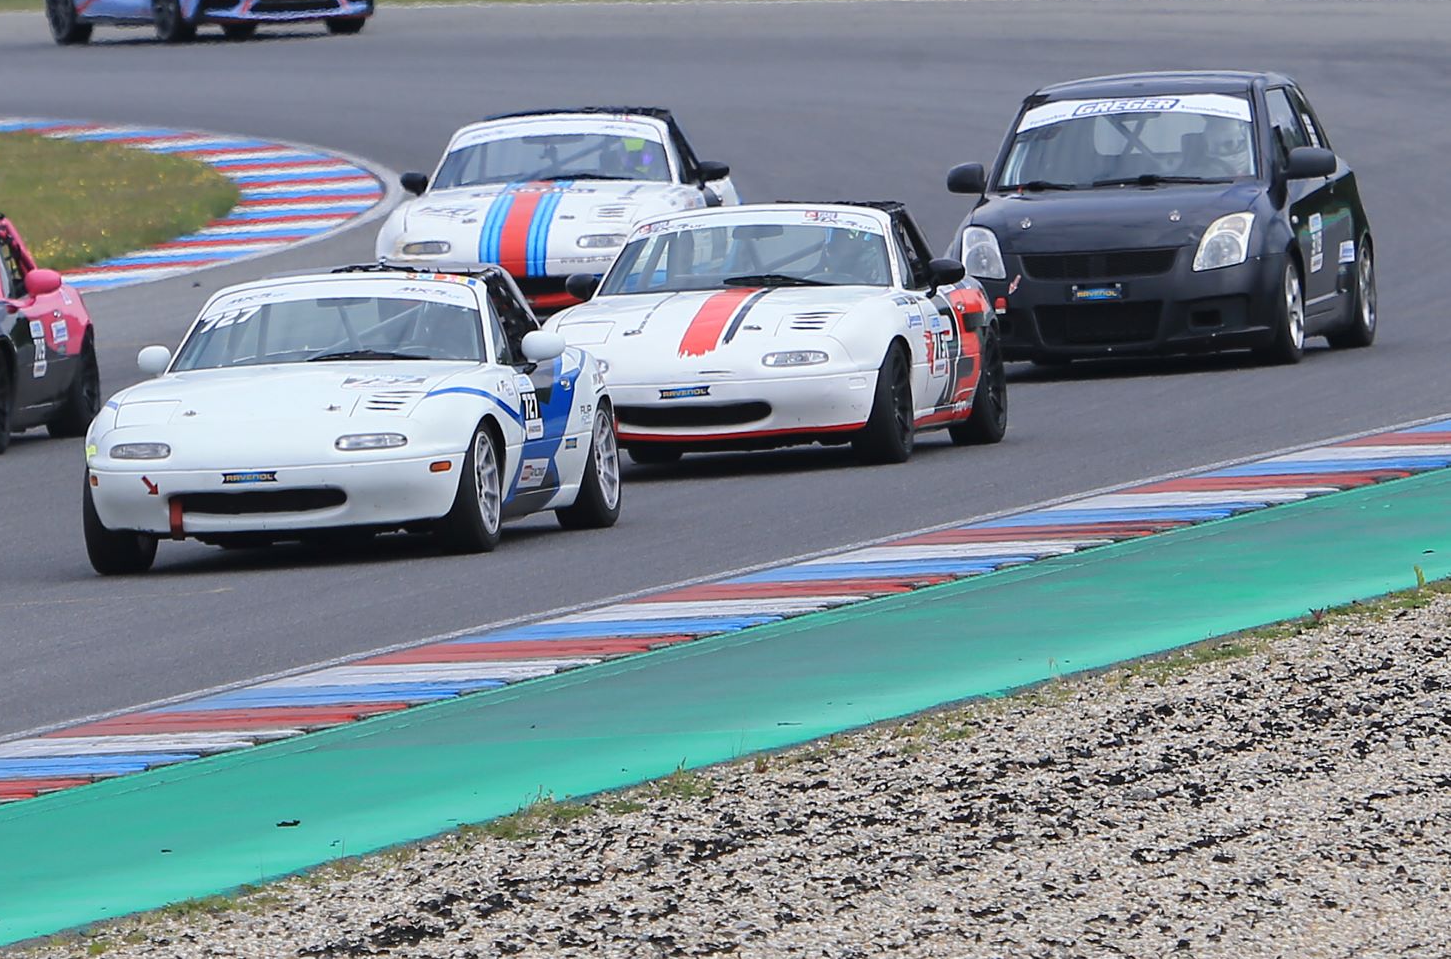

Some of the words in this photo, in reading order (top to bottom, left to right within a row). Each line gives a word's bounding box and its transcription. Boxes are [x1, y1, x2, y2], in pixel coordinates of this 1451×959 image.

[1078, 98, 1177, 116] GREGER
[200, 305, 262, 334] 727
[662, 388, 707, 397] RAVENOL
[521, 392, 539, 419] 727
[226, 473, 274, 482] RAVENOL
